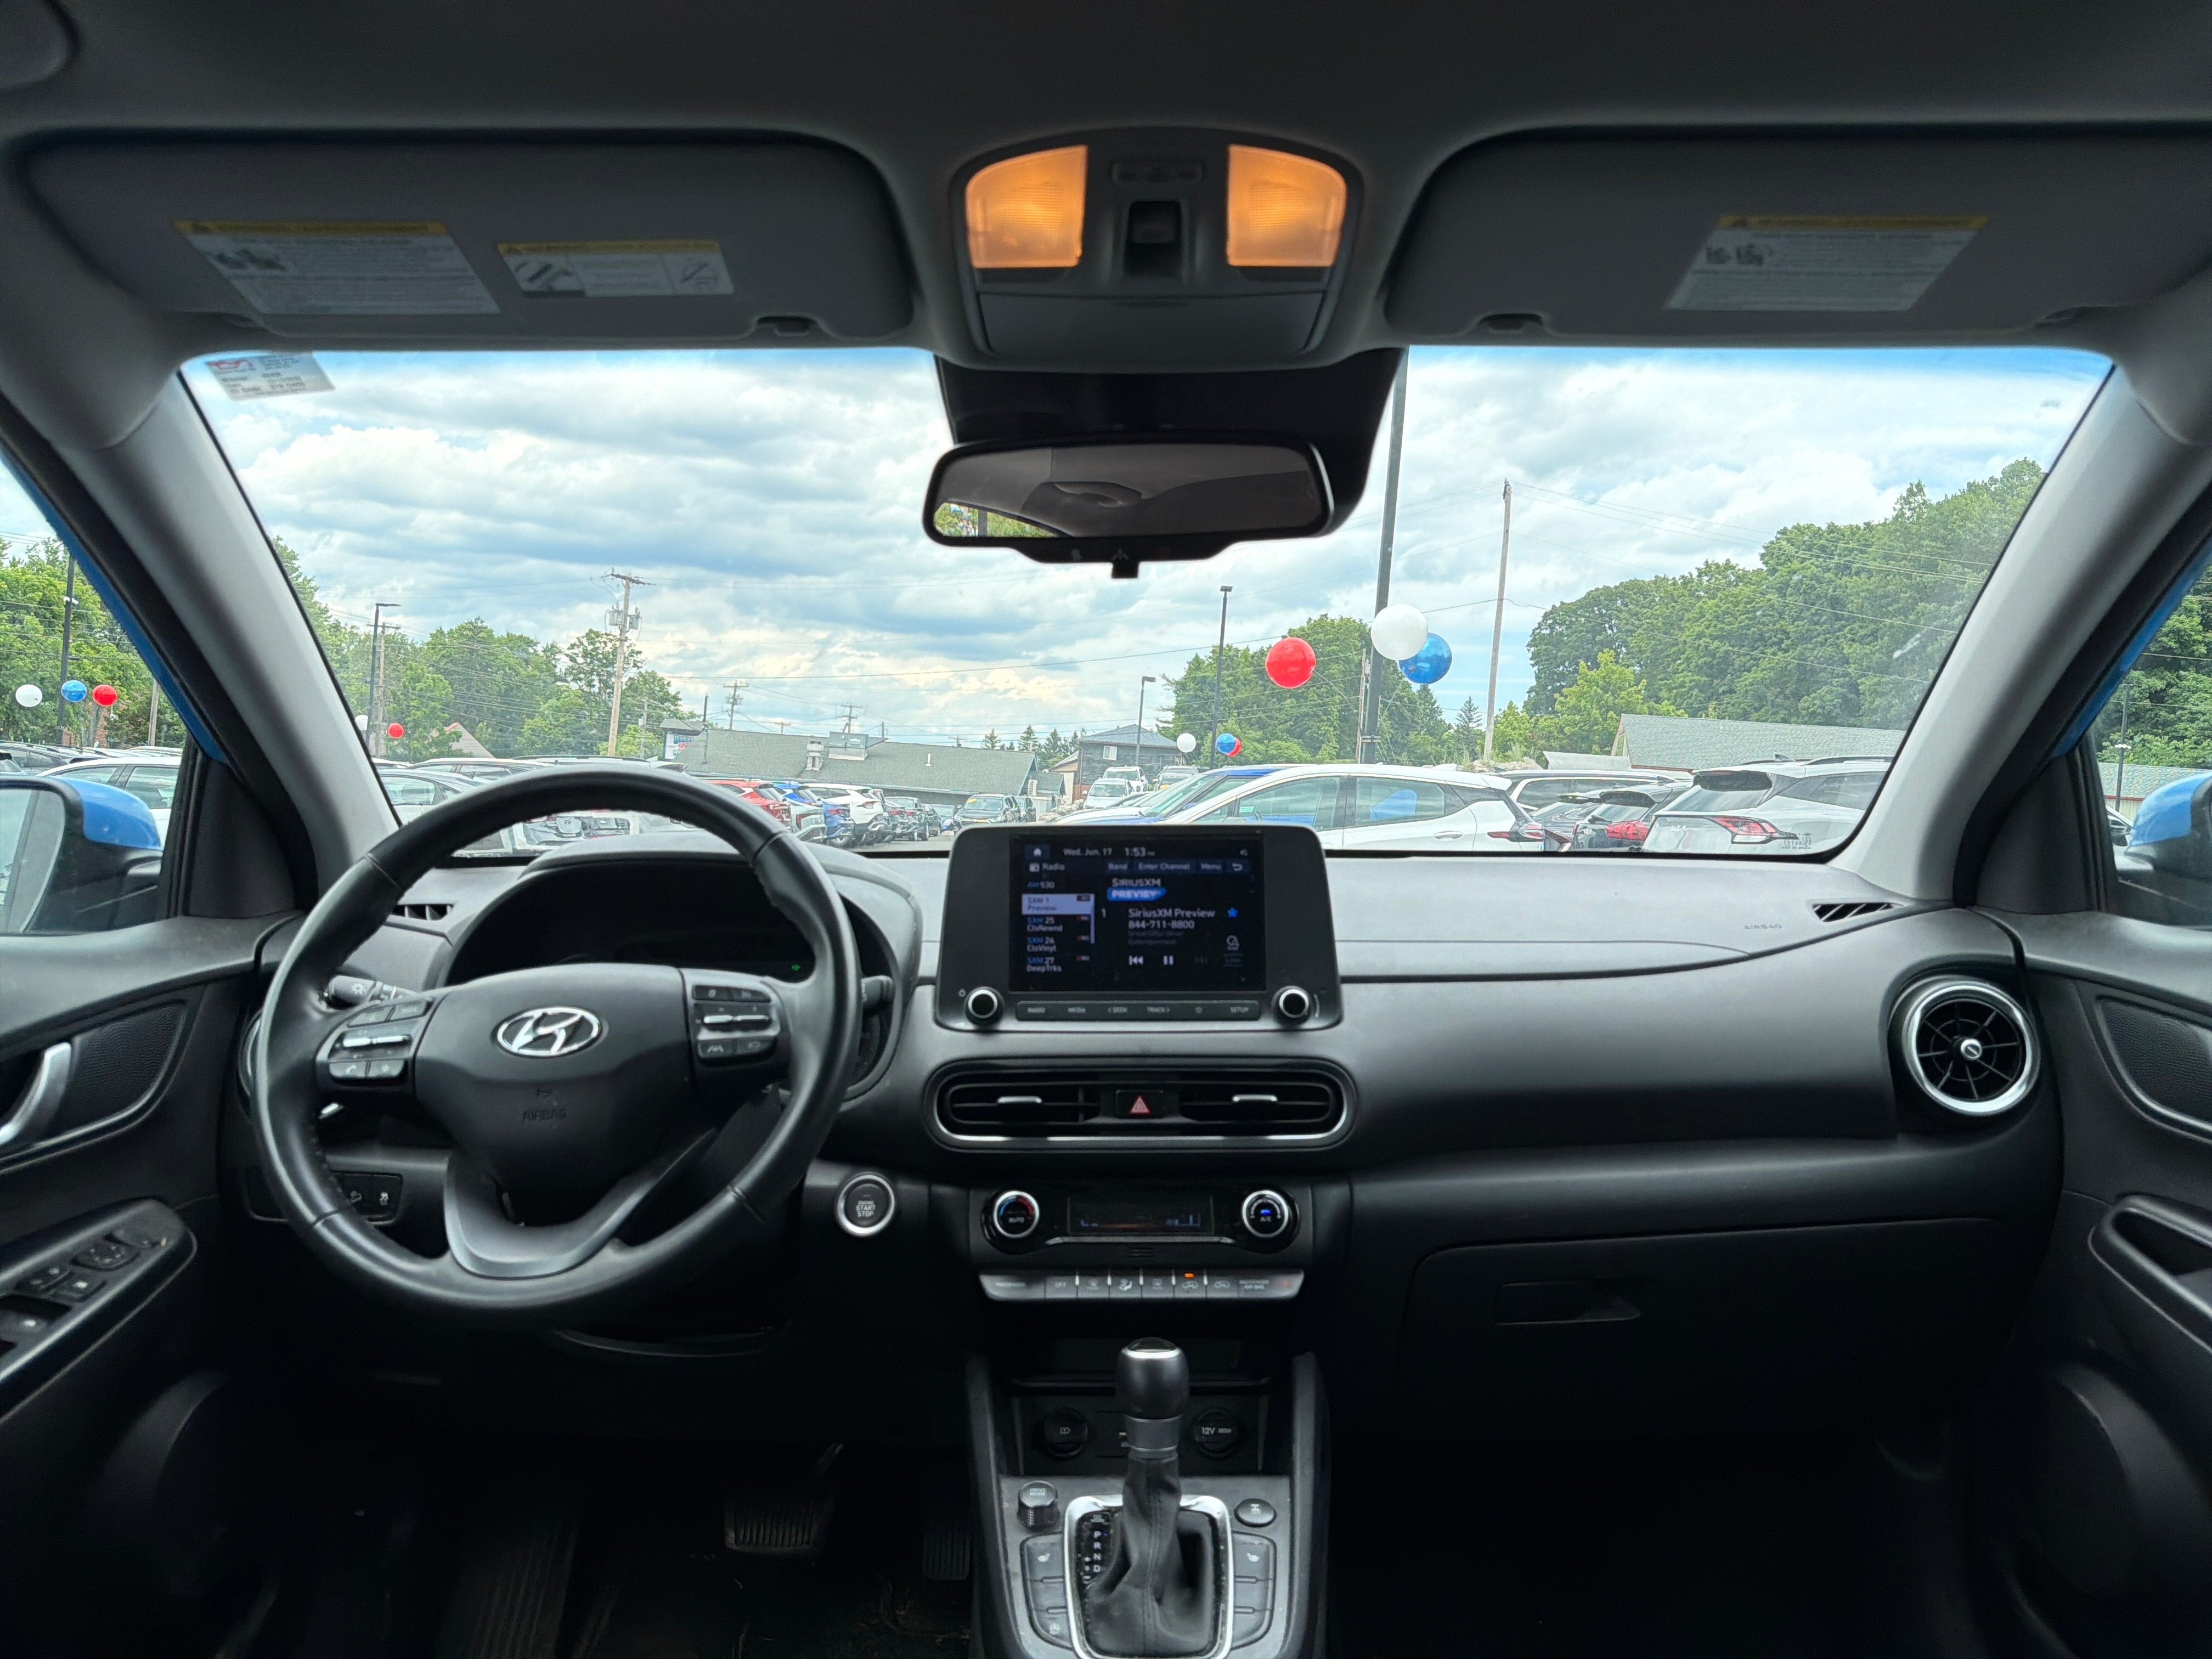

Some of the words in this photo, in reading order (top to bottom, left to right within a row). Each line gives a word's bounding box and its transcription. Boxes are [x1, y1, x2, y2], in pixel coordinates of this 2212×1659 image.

[1103, 848, 1113, 856] 17
[1125, 847, 1147, 857] 1:53
[1043, 862, 1065, 871] Radio
[1160, 862, 1190, 871] Channel
[1128, 908, 1172, 918] SiriusXM
[1174, 908, 1216, 918] Preview
[1045, 916, 1055, 924] 25
[1128, 920, 1195, 929] 844-711-8800
[1201, 1427, 1216, 1435] 12V
[1093, 1531, 1102, 1539] P
[1093, 1542, 1102, 1550] R
[1093, 1553, 1102, 1561] N
[1093, 1564, 1101, 1573] D
